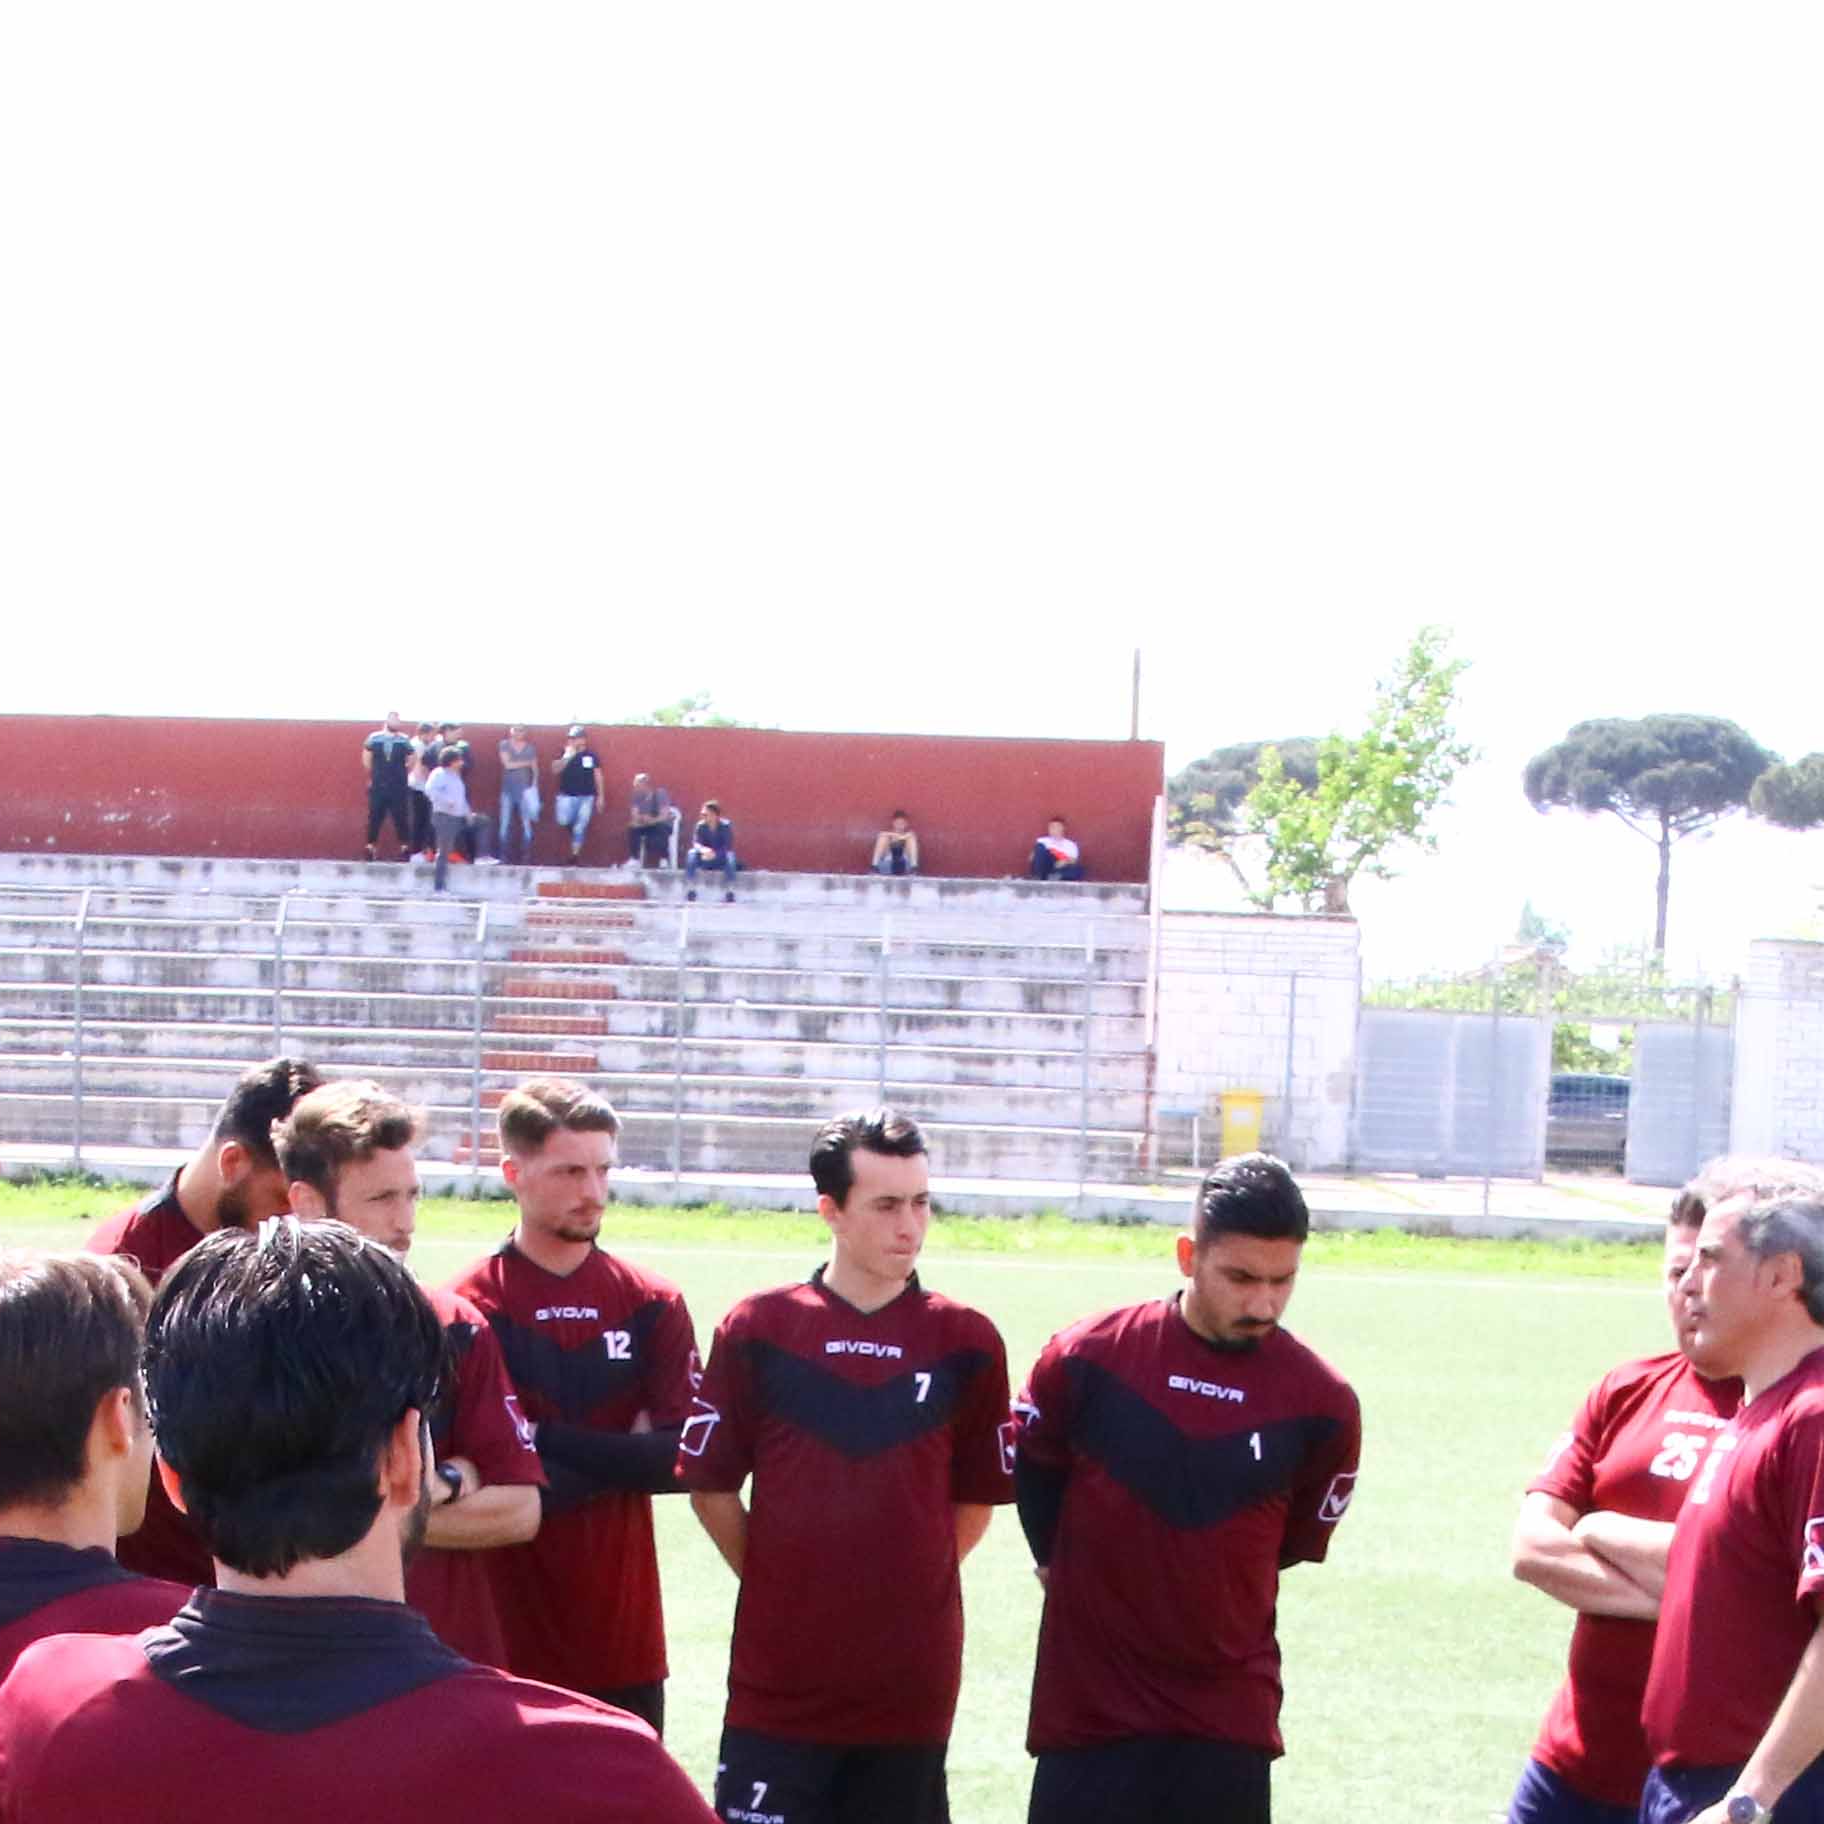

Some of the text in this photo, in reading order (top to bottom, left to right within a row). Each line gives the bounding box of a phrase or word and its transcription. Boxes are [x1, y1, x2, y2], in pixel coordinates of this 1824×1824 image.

[602, 1330, 633, 1360] 12
[825, 1340, 903, 1360] GIVOVA
[914, 1371, 932, 1403] 7
[1168, 1374, 1245, 1404] GIVOVA
[1248, 1432, 1262, 1461] 1
[1648, 1430, 1708, 1482] 25
[750, 1780, 768, 1810] 7
